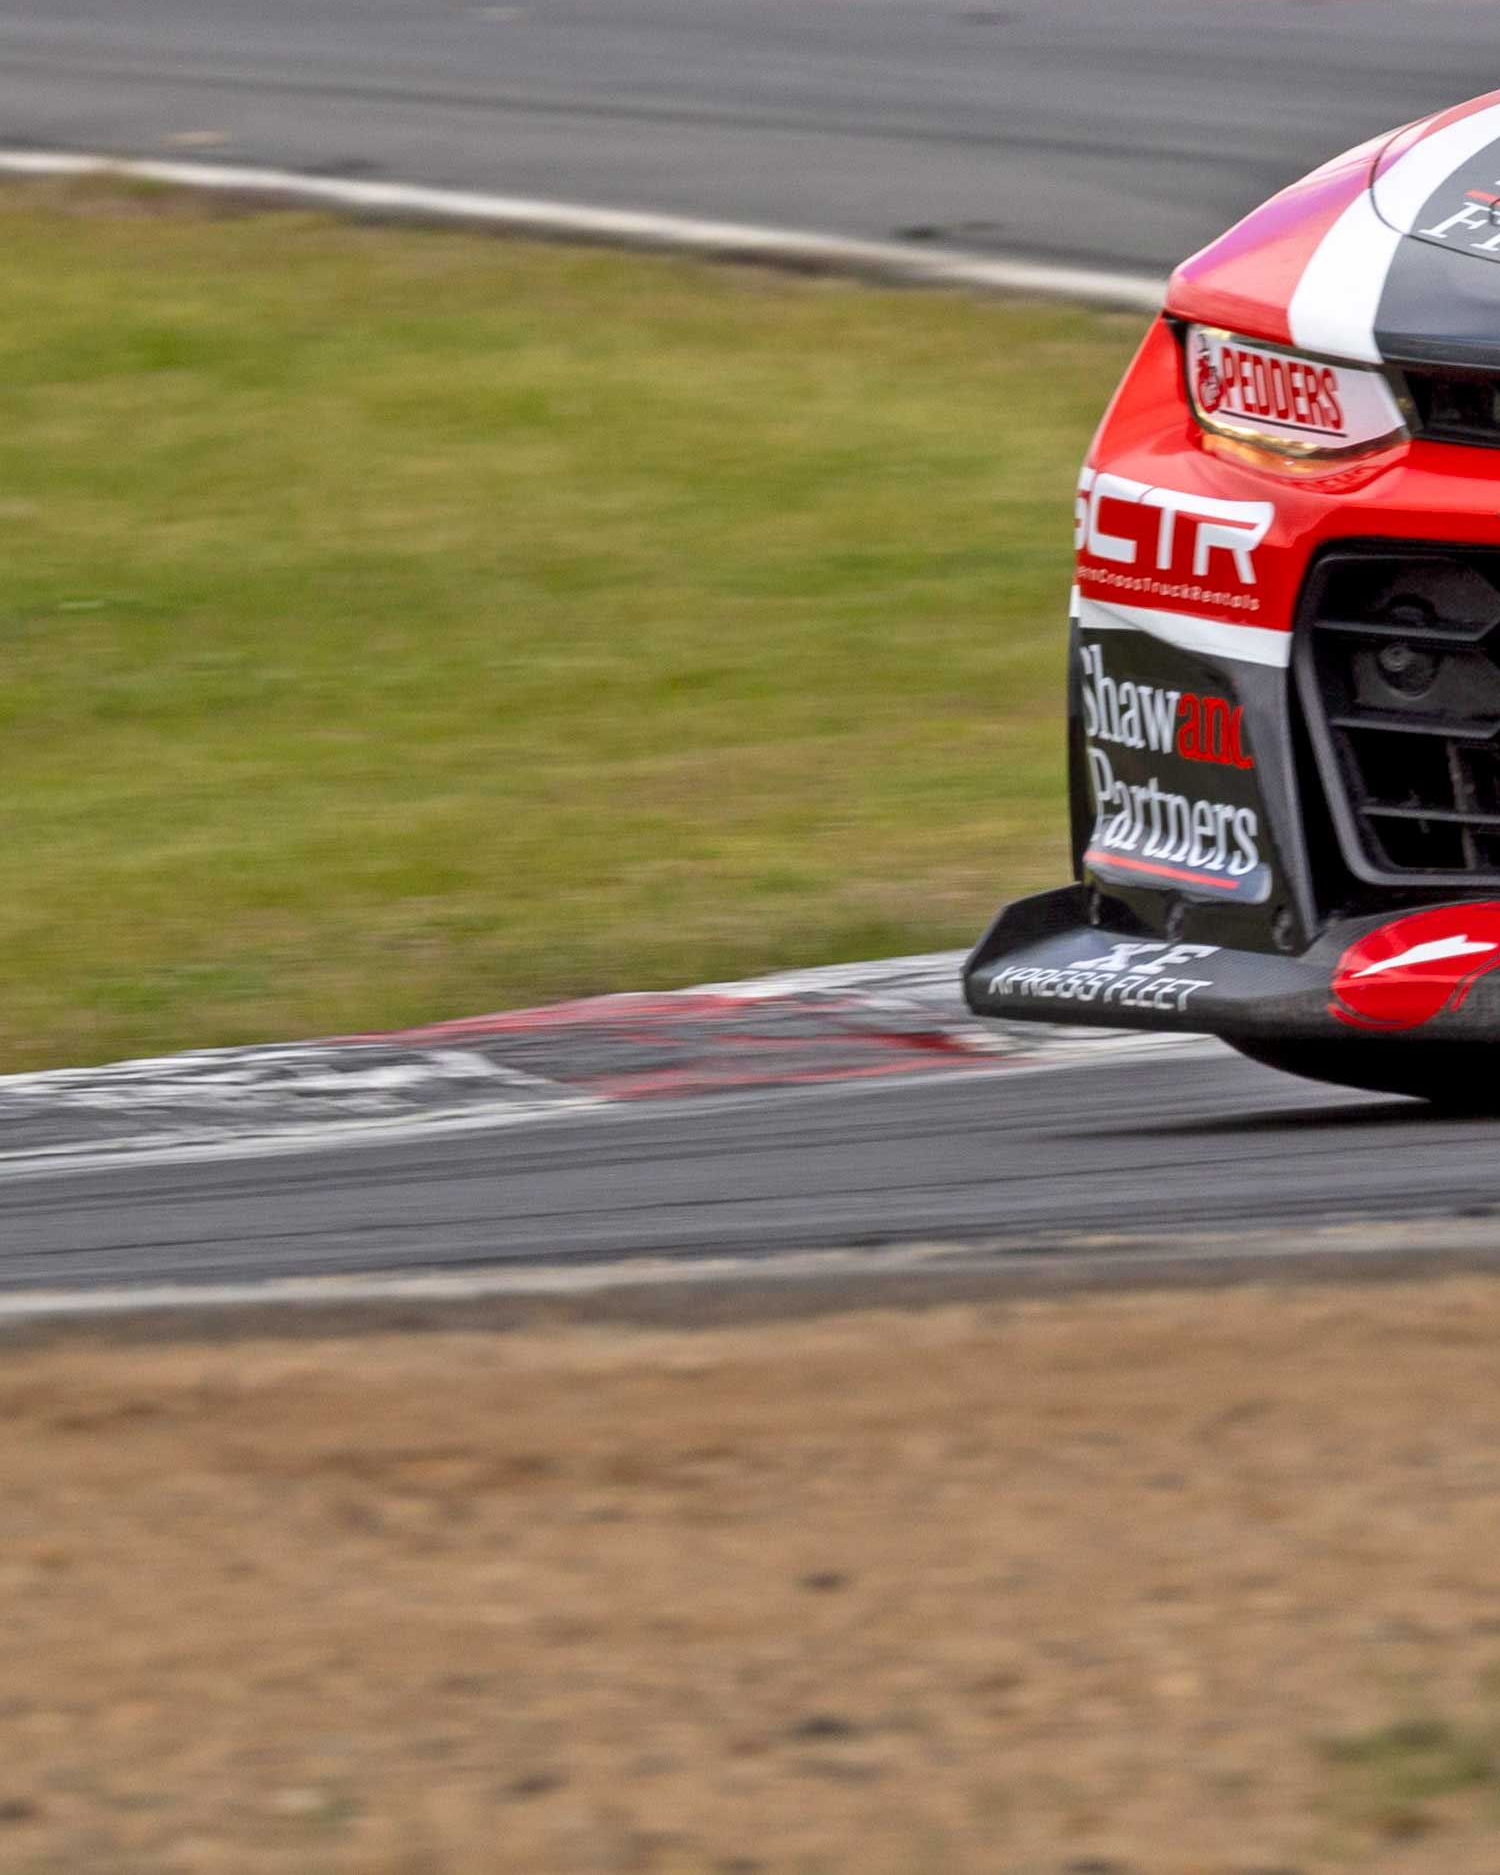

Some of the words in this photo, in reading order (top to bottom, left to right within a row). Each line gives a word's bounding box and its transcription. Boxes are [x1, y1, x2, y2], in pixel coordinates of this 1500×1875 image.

[1220, 346, 1344, 430] PEDDERS
[1087, 746, 1260, 876] Partners
[987, 966, 1118, 1002] XPRESS
[1103, 975, 1214, 1012] FLEET
